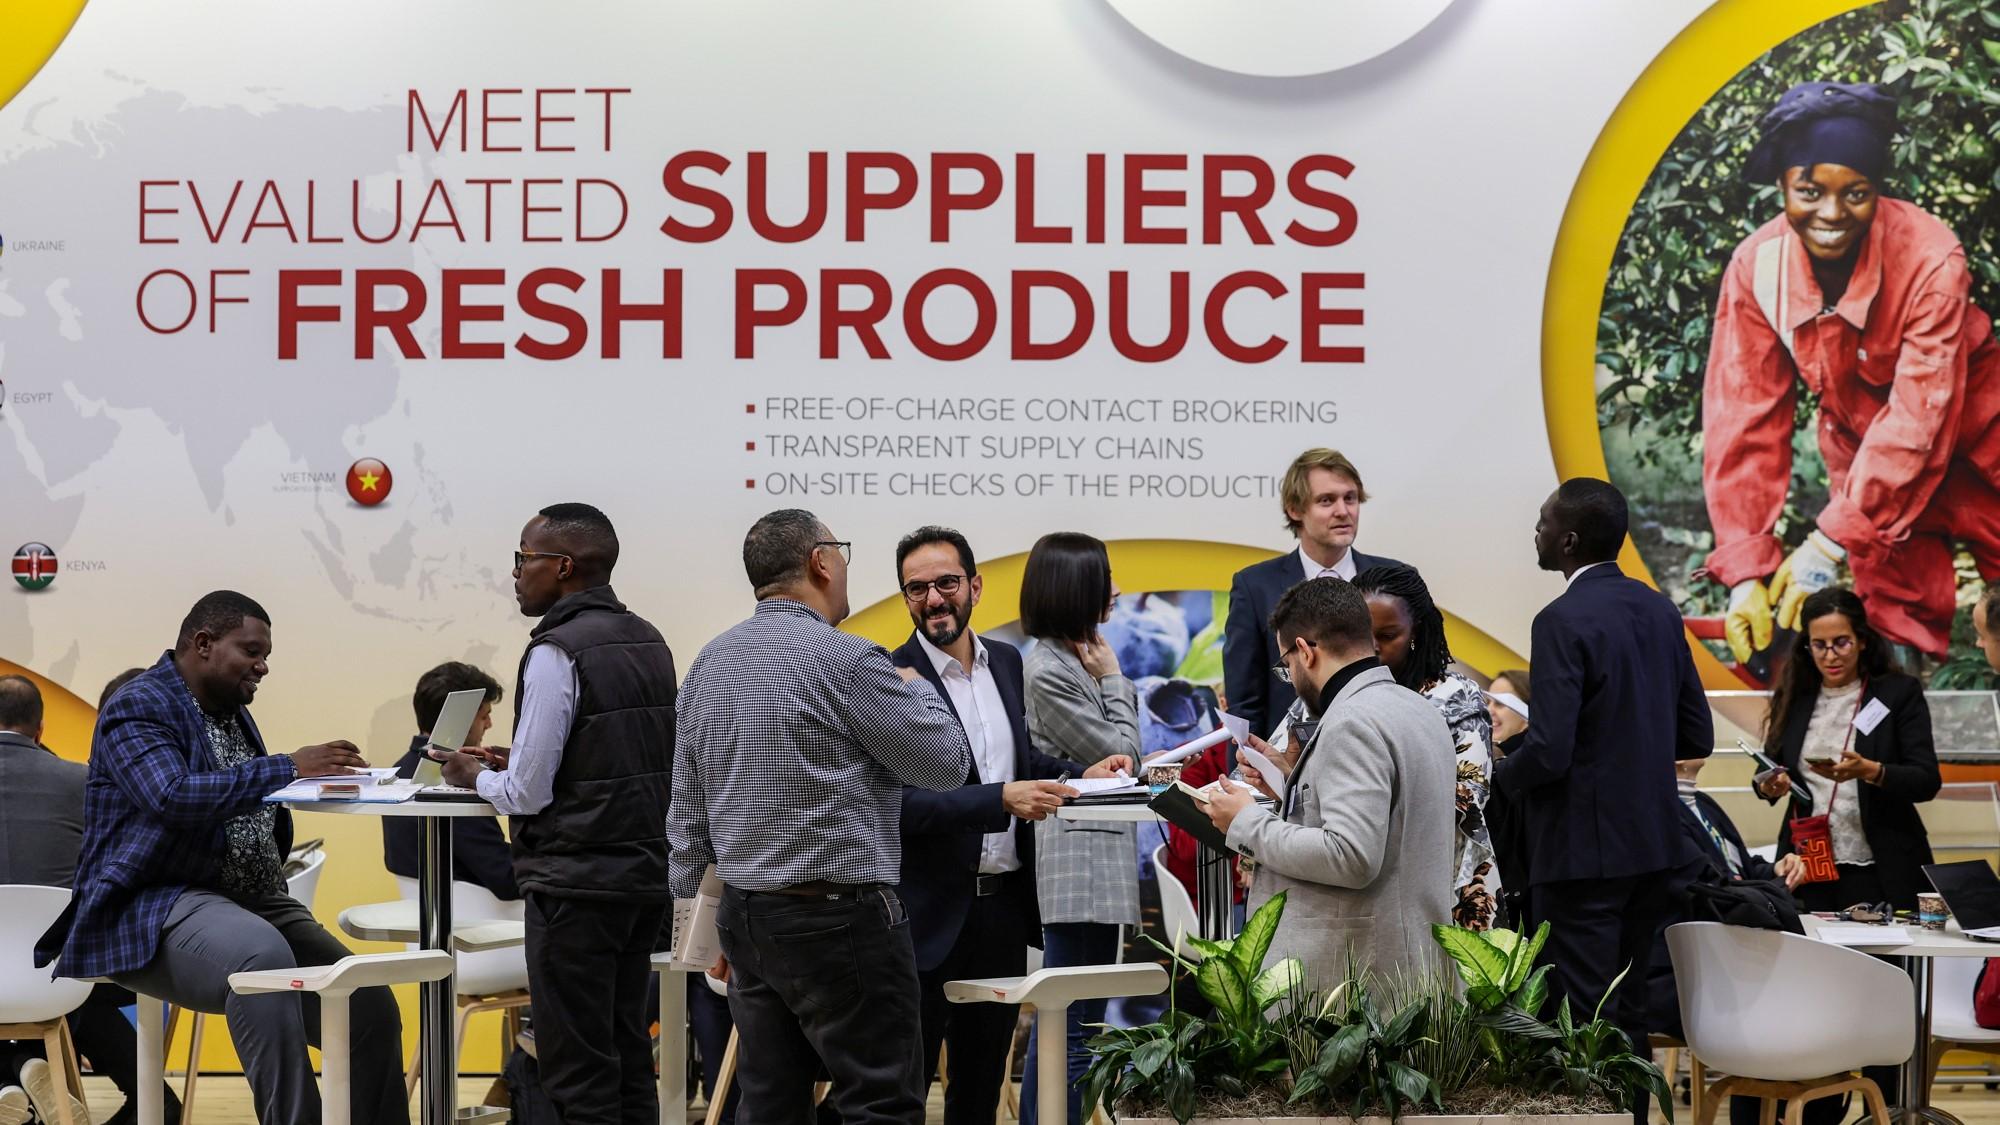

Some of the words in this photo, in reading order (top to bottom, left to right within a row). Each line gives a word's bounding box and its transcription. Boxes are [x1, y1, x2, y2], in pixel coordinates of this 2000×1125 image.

[408, 88, 631, 152] MEET
[139, 179, 628, 243] EVALUATED
[660, 150, 1358, 247] SUPPLIERS
[12, 240, 65, 251] UKRAINE
[136, 269, 250, 334] OF
[278, 267, 683, 361] FRESH
[735, 267, 1366, 364] PRODUCE
[14, 392, 54, 403] EGYPT
[765, 397, 1015, 422] FREE-OF-CHARGE
[1024, 398, 1163, 423] CONTACT
[1173, 400, 1338, 424] BROKERING
[765, 435, 971, 458] TRANSPARENT
[980, 436, 1086, 460] SUPPLY
[1095, 437, 1204, 461] CHAINS
[280, 472, 336, 483] VIETNAM
[765, 472, 878, 496] ON-SITE
[888, 473, 1005, 497] CHECKS
[1014, 473, 1054, 497] OF
[1063, 474, 1119, 498] THE
[1129, 475, 1282, 499] PRODUCTI
[66, 560, 106, 571] KENYA
